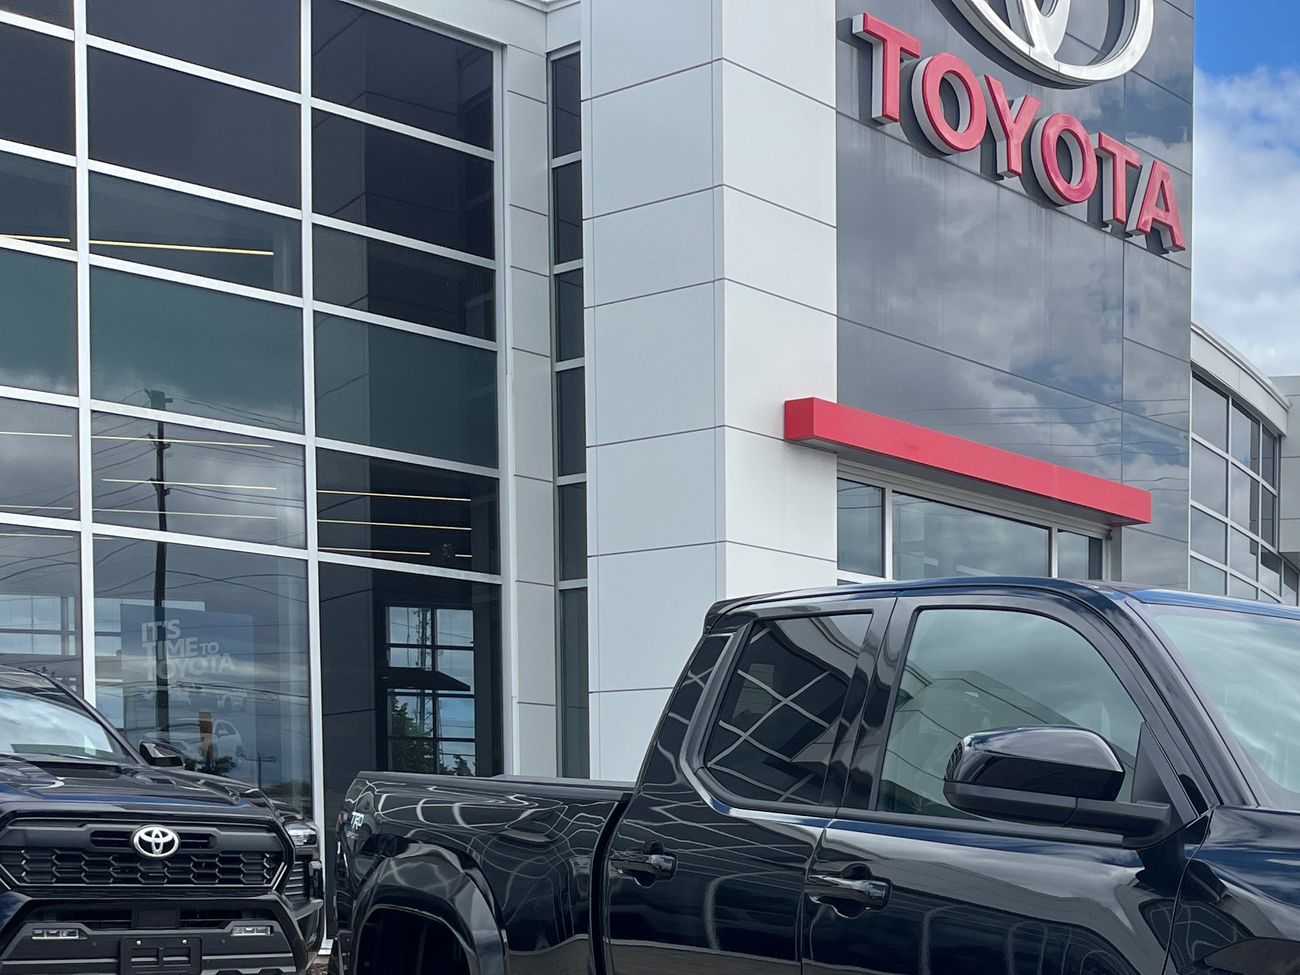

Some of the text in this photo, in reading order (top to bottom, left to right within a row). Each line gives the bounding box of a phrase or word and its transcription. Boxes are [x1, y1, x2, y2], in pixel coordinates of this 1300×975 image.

[853, 11, 1185, 251] TOYOTA
[141, 618, 181, 642] IT'S
[142, 637, 219, 660] TIME TO
[143, 652, 236, 681] TOYOTA
[350, 811, 365, 830] TRD
